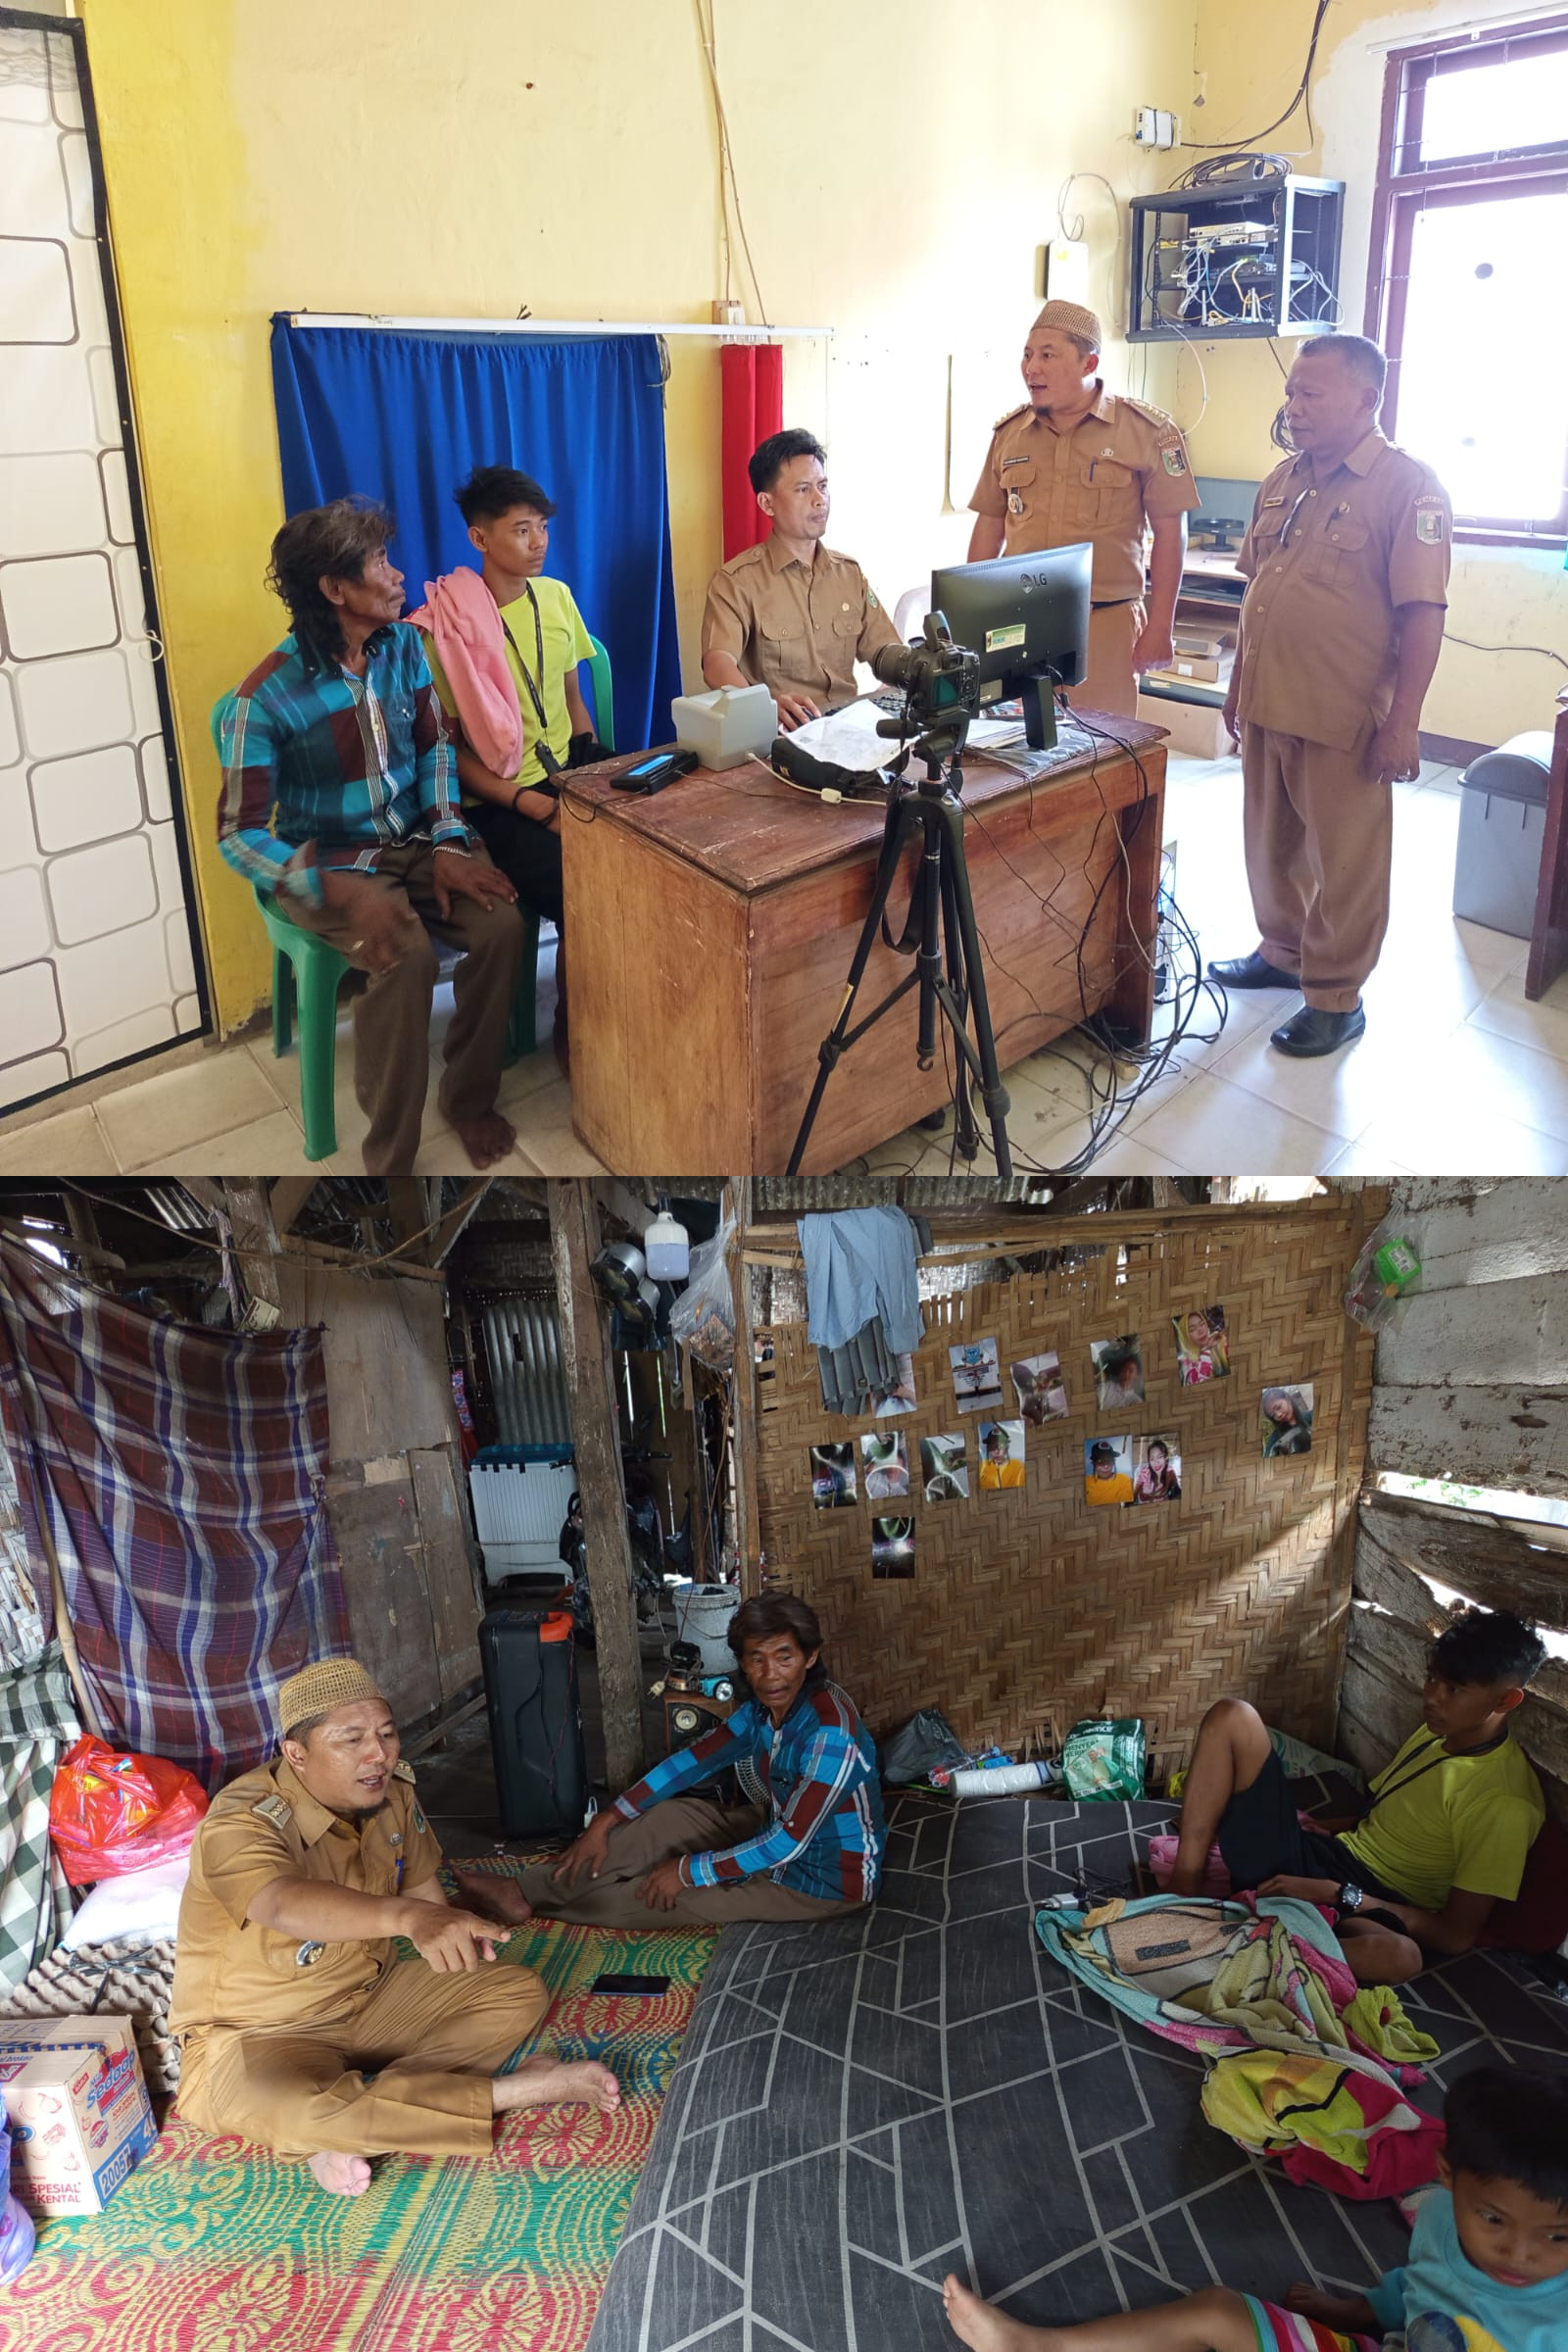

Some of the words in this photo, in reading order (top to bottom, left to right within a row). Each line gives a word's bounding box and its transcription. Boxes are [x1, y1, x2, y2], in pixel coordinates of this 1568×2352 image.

[1033, 573, 1048, 586] LG
[85, 2049, 135, 2110] Sedaap
[29, 2182, 80, 2194] SPESIAL
[37, 2194, 80, 2204] KENTAL
